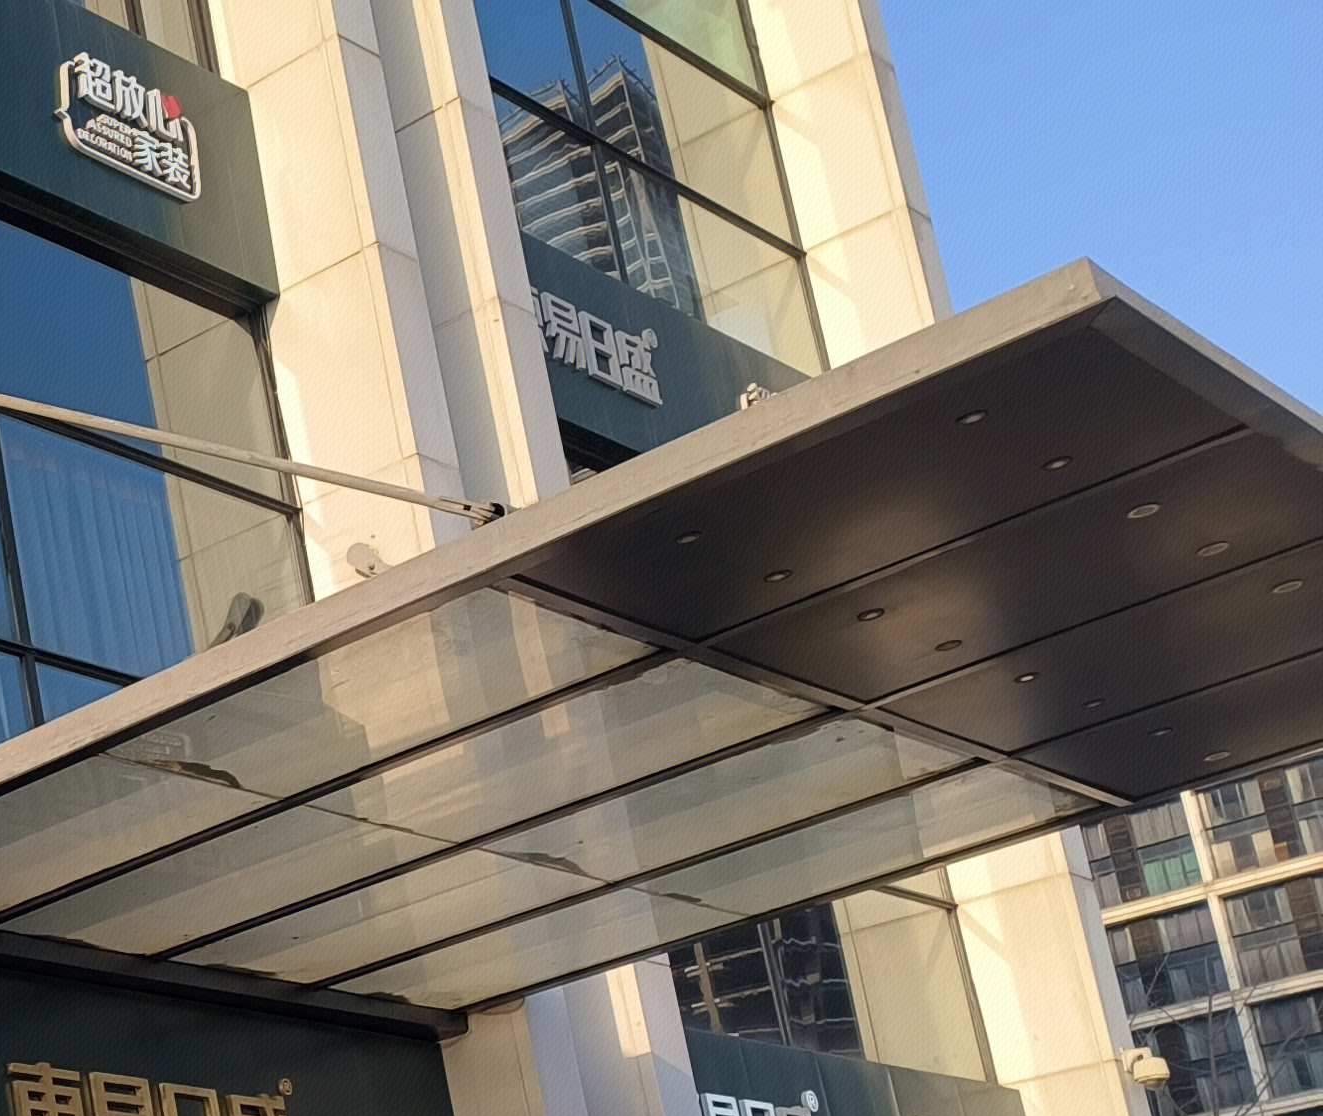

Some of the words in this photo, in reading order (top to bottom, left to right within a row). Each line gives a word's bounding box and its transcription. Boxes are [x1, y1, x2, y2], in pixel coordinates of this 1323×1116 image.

[74, 52, 183, 144] 超放心
[132, 128, 192, 191] 家装
[531, 286, 663, 407] 易日盛
